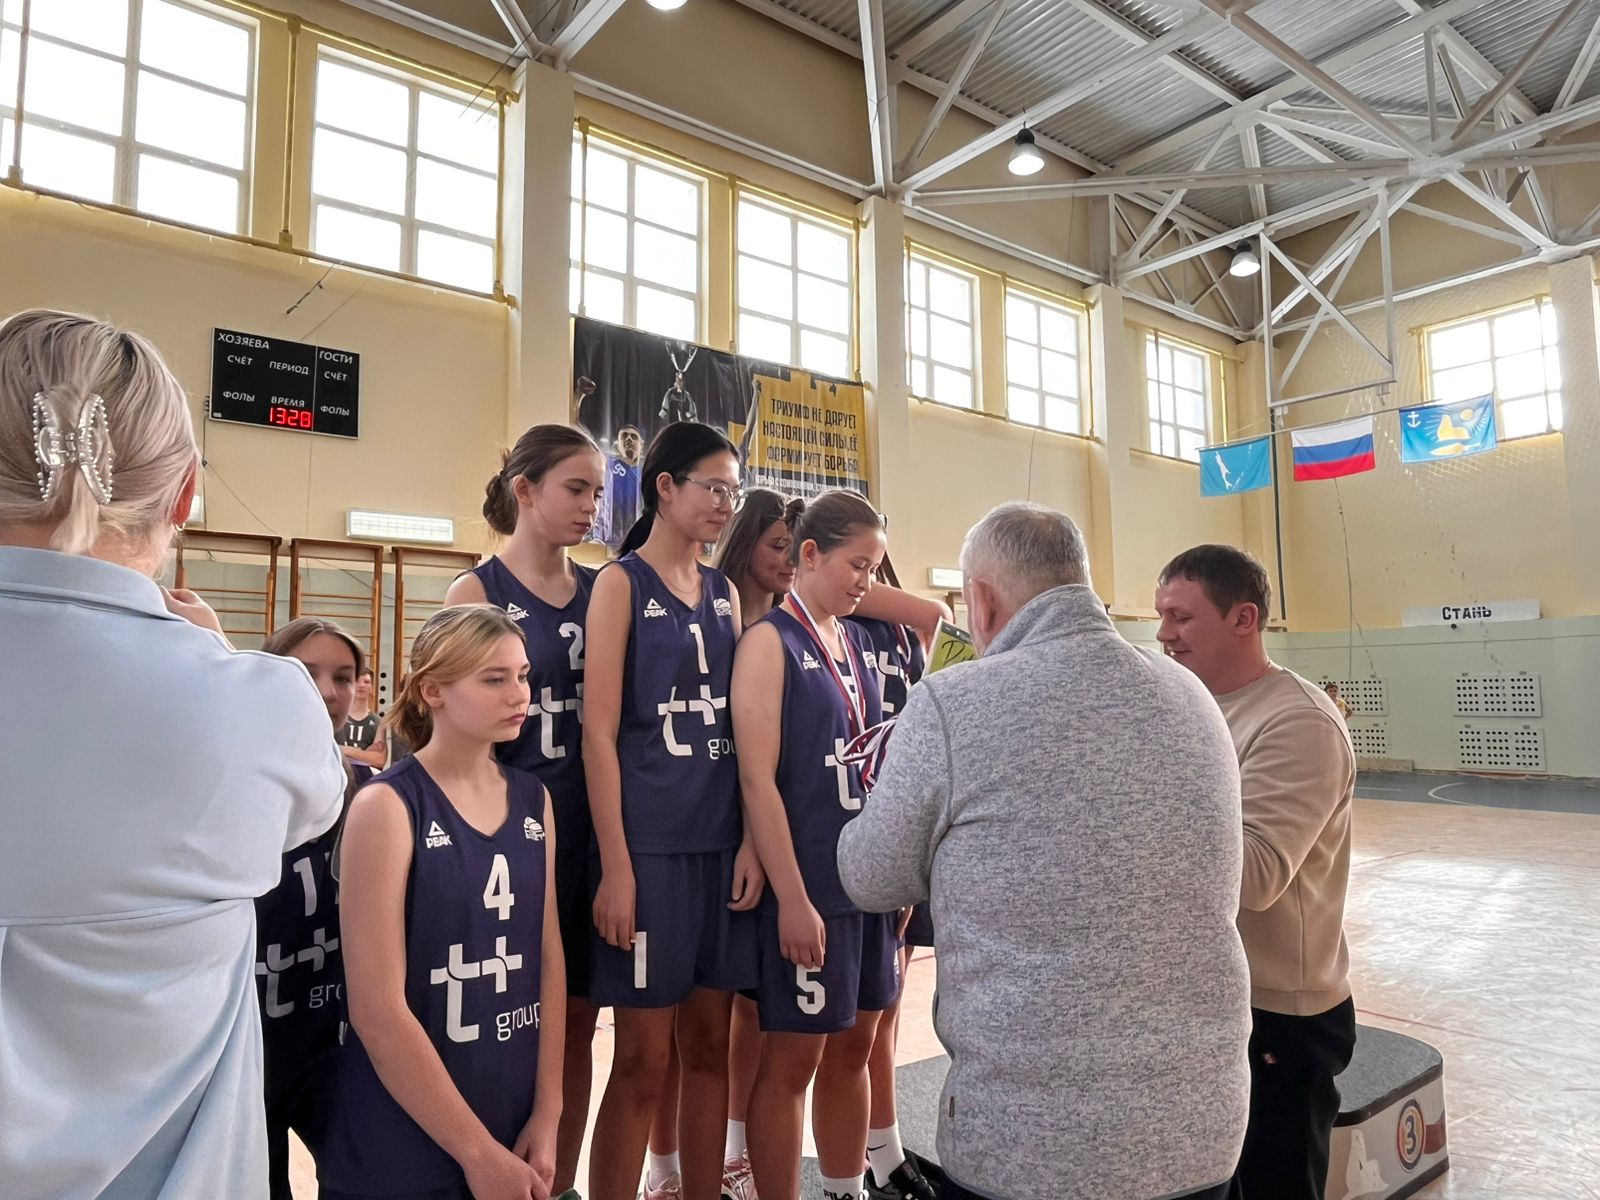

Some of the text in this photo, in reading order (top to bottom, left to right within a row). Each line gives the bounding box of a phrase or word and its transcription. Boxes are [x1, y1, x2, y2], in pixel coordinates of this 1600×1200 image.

[217, 332, 270, 350] ХОЗЯЕВА
[269, 361, 309, 375] ПЕРИОД
[319, 350, 354, 364] ГОСТИ
[222, 390, 256, 402] ФОЛЫ
[271, 396, 305, 408] ВРЕМЯ
[320, 405, 350, 416] ФОЛЫ
[771, 398, 857, 429] ТРИУМФ НЕ ДАРУЕТ
[762, 420, 817, 447] НАСТОЯЩЕЙ
[766, 445, 858, 474] ФОРМИРУЕТ БОРЬБА
[643, 607, 668, 618] PEAK
[558, 622, 585, 671] 2
[688, 623, 710, 674] 1
[425, 835, 453, 849] PEAK
[483, 853, 515, 921] 4
[630, 931, 647, 989] 1
[796, 963, 826, 1015] 5
[496, 1002, 540, 1041] group
[1404, 1115, 1417, 1155] 3
